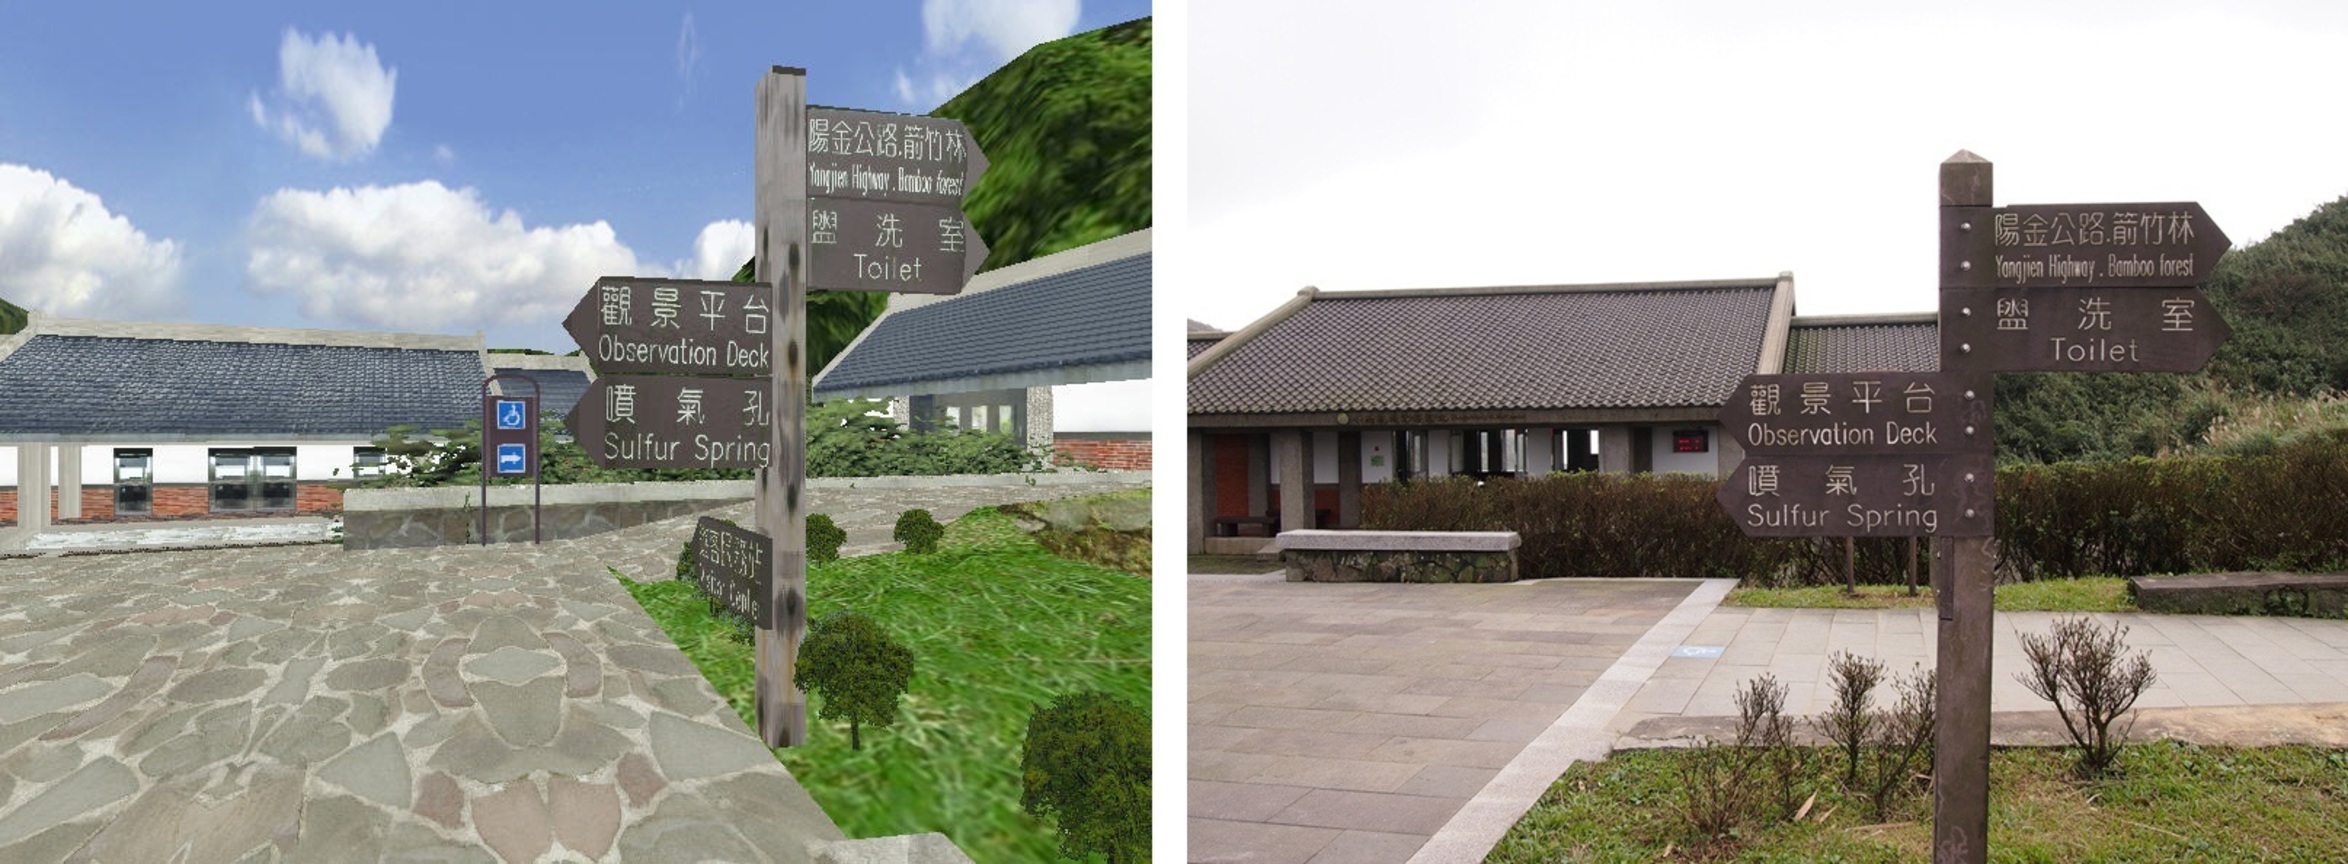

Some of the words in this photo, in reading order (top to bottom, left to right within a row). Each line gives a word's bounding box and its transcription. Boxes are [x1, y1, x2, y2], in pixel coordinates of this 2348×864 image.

[936, 170, 965, 196] forest
[853, 253, 922, 281] Toilet
[1995, 254, 2044, 284] Yangjien
[2049, 254, 2096, 283] Highway
[2108, 253, 2155, 277] Bamboo
[2159, 253, 2194, 277] forest
[600, 286, 770, 334] 觀景平台
[1996, 297, 2195, 332] 盥洗室
[599, 334, 718, 367] Observation
[726, 340, 769, 369] Deck
[2050, 337, 2140, 363] Toilet
[605, 383, 770, 427] 噴氣孔
[1750, 381, 1936, 416] 觀景平台
[604, 431, 681, 461] Sulfur
[694, 433, 771, 469] Spring
[1747, 421, 1875, 446] Observation
[1886, 421, 1938, 445] Deck
[1749, 464, 1936, 497] 噴氣孔
[1747, 503, 1830, 528] Sulfur
[1847, 503, 1938, 533] Spring
